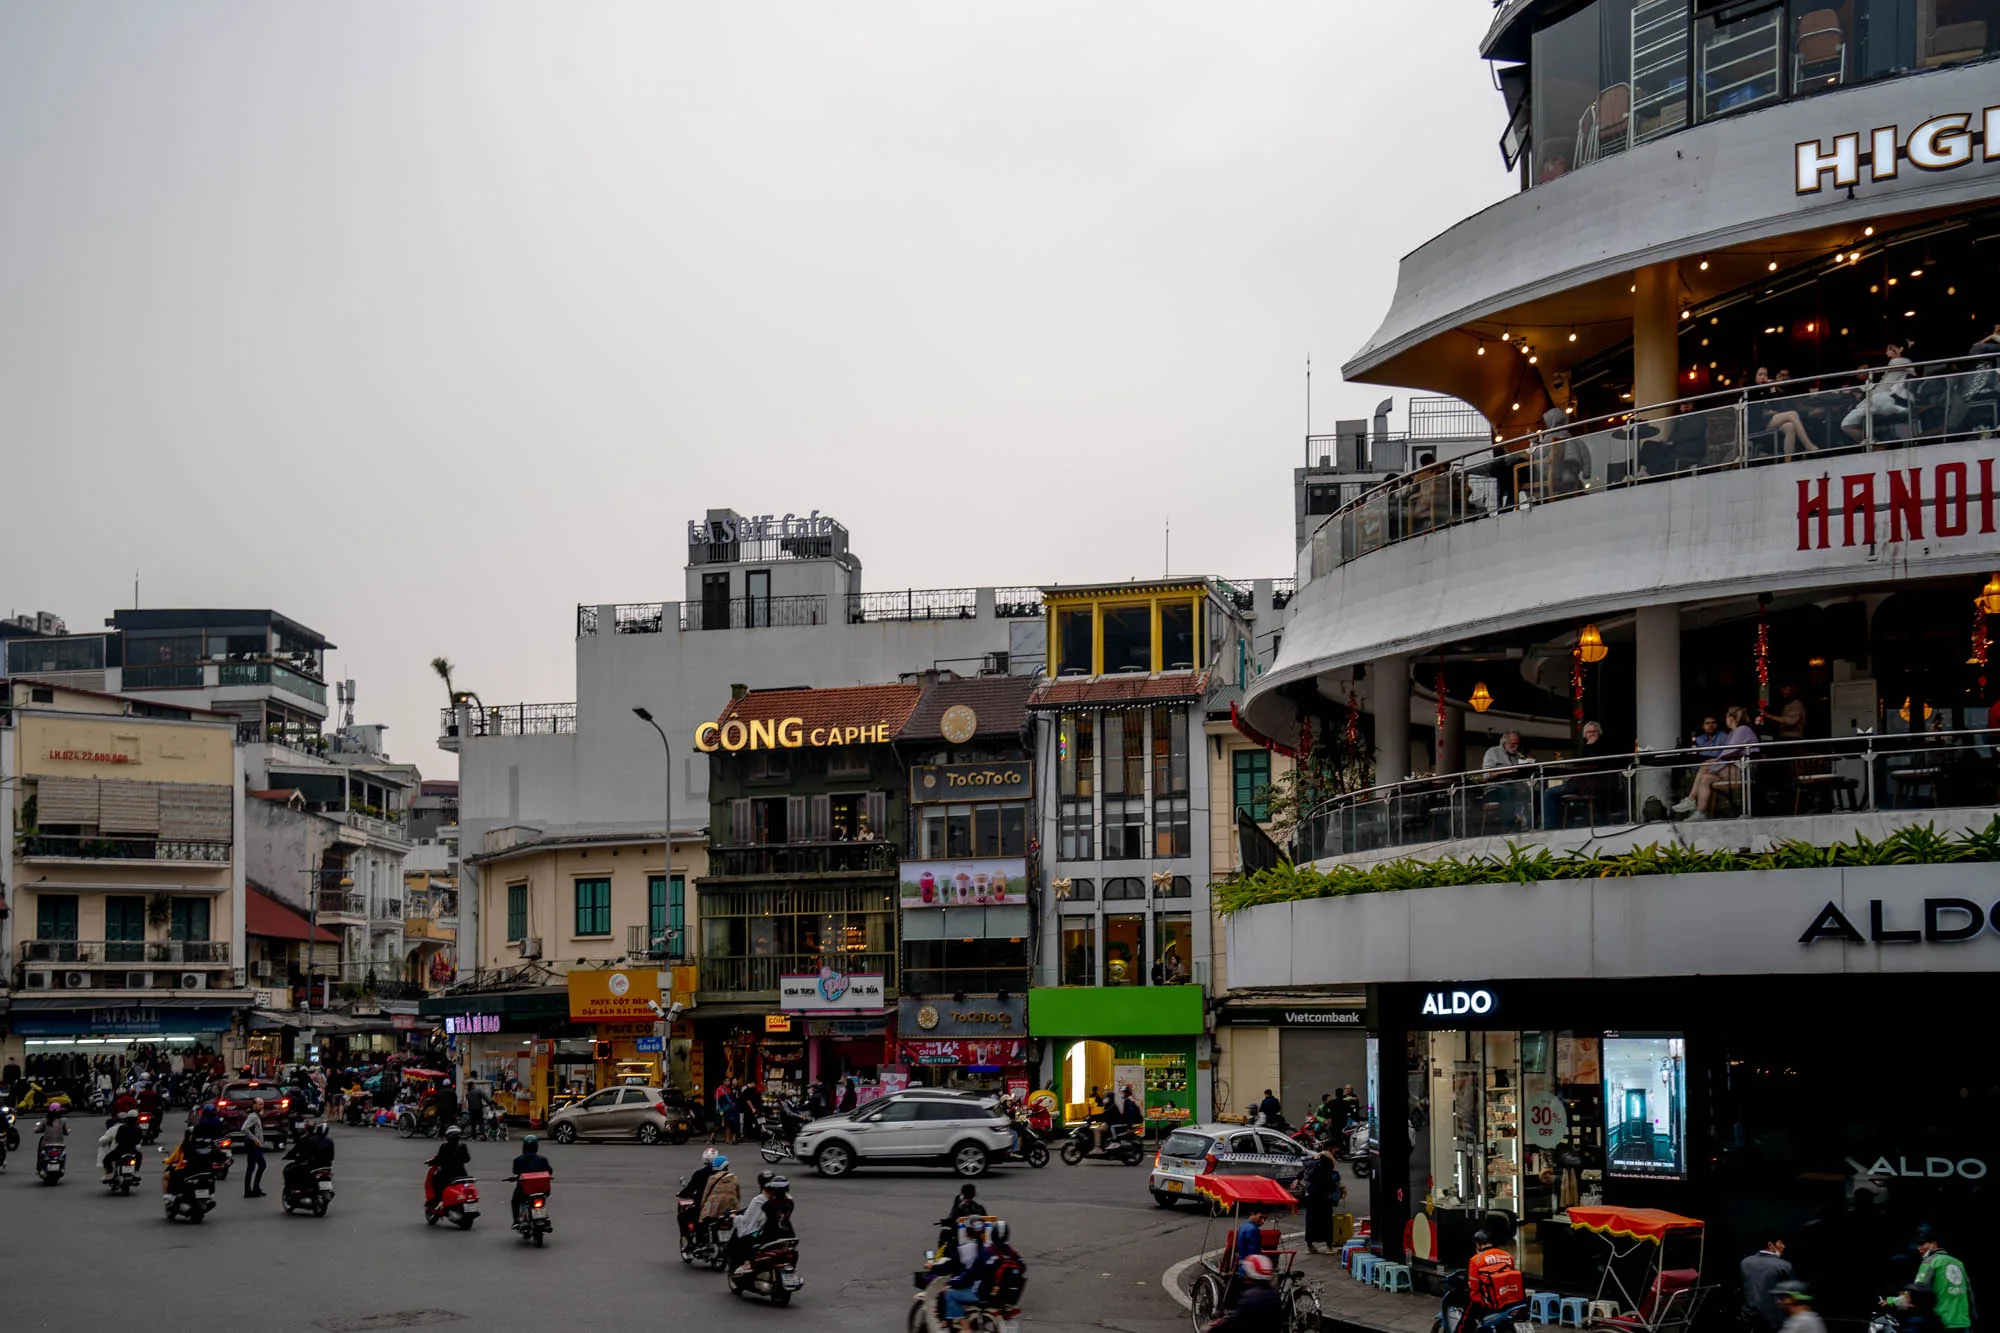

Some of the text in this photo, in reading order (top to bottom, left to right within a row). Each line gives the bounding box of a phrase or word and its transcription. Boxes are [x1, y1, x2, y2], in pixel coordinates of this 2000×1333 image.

[1795, 105, 2000, 196] HIG
[1796, 458, 1996, 551] HANOI
[687, 509, 833, 545] LA SOIE Cafe
[1797, 897, 2000, 944] ALD
[1421, 990, 1492, 1016] ALDO
[1284, 1011, 1361, 1024] Vietcombank
[1531, 1105, 1563, 1126] 30%
[1538, 1128, 1553, 1137] OFF
[1866, 1155, 1988, 1180] ALDO
